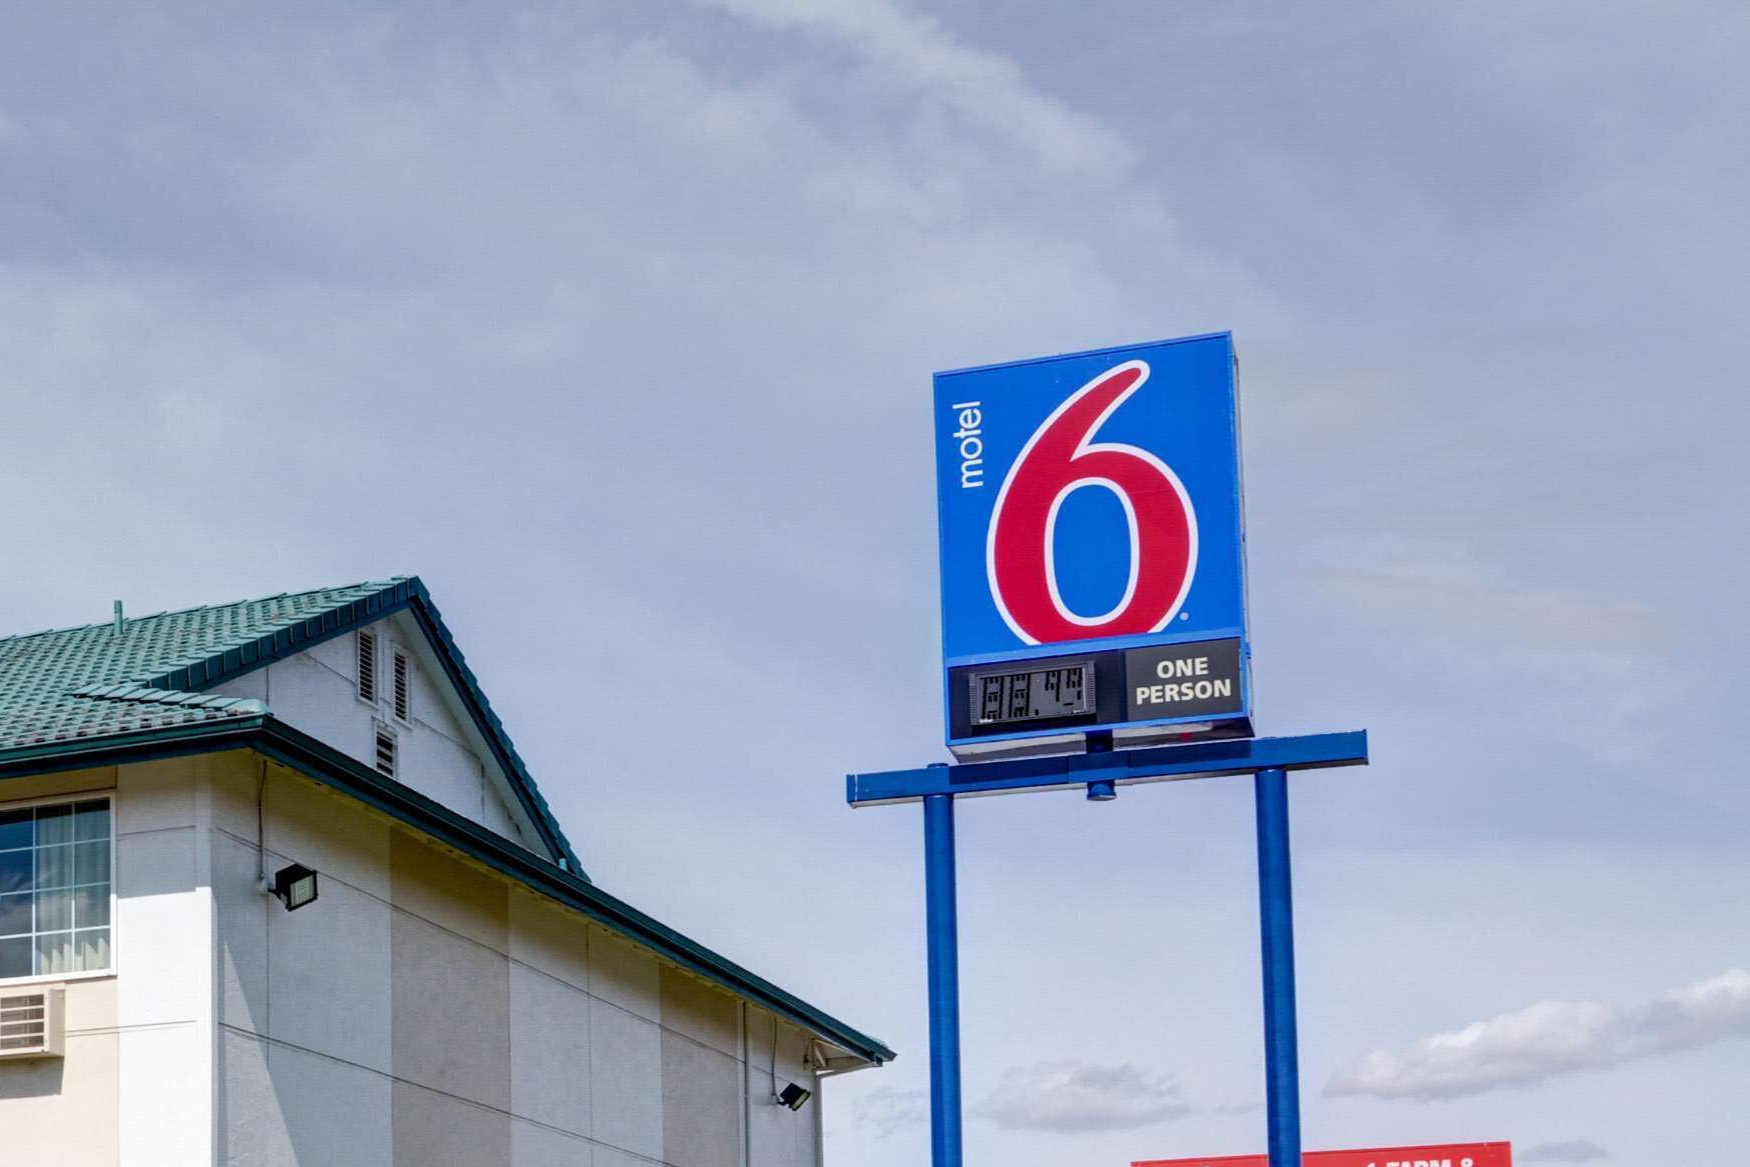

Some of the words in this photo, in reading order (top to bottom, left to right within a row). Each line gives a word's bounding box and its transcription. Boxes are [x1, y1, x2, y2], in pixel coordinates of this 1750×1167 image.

[952, 401, 984, 489] motel
[986, 359, 1199, 646] 6
[1156, 656, 1209, 679] ONE
[1136, 678, 1232, 705] PERSON
